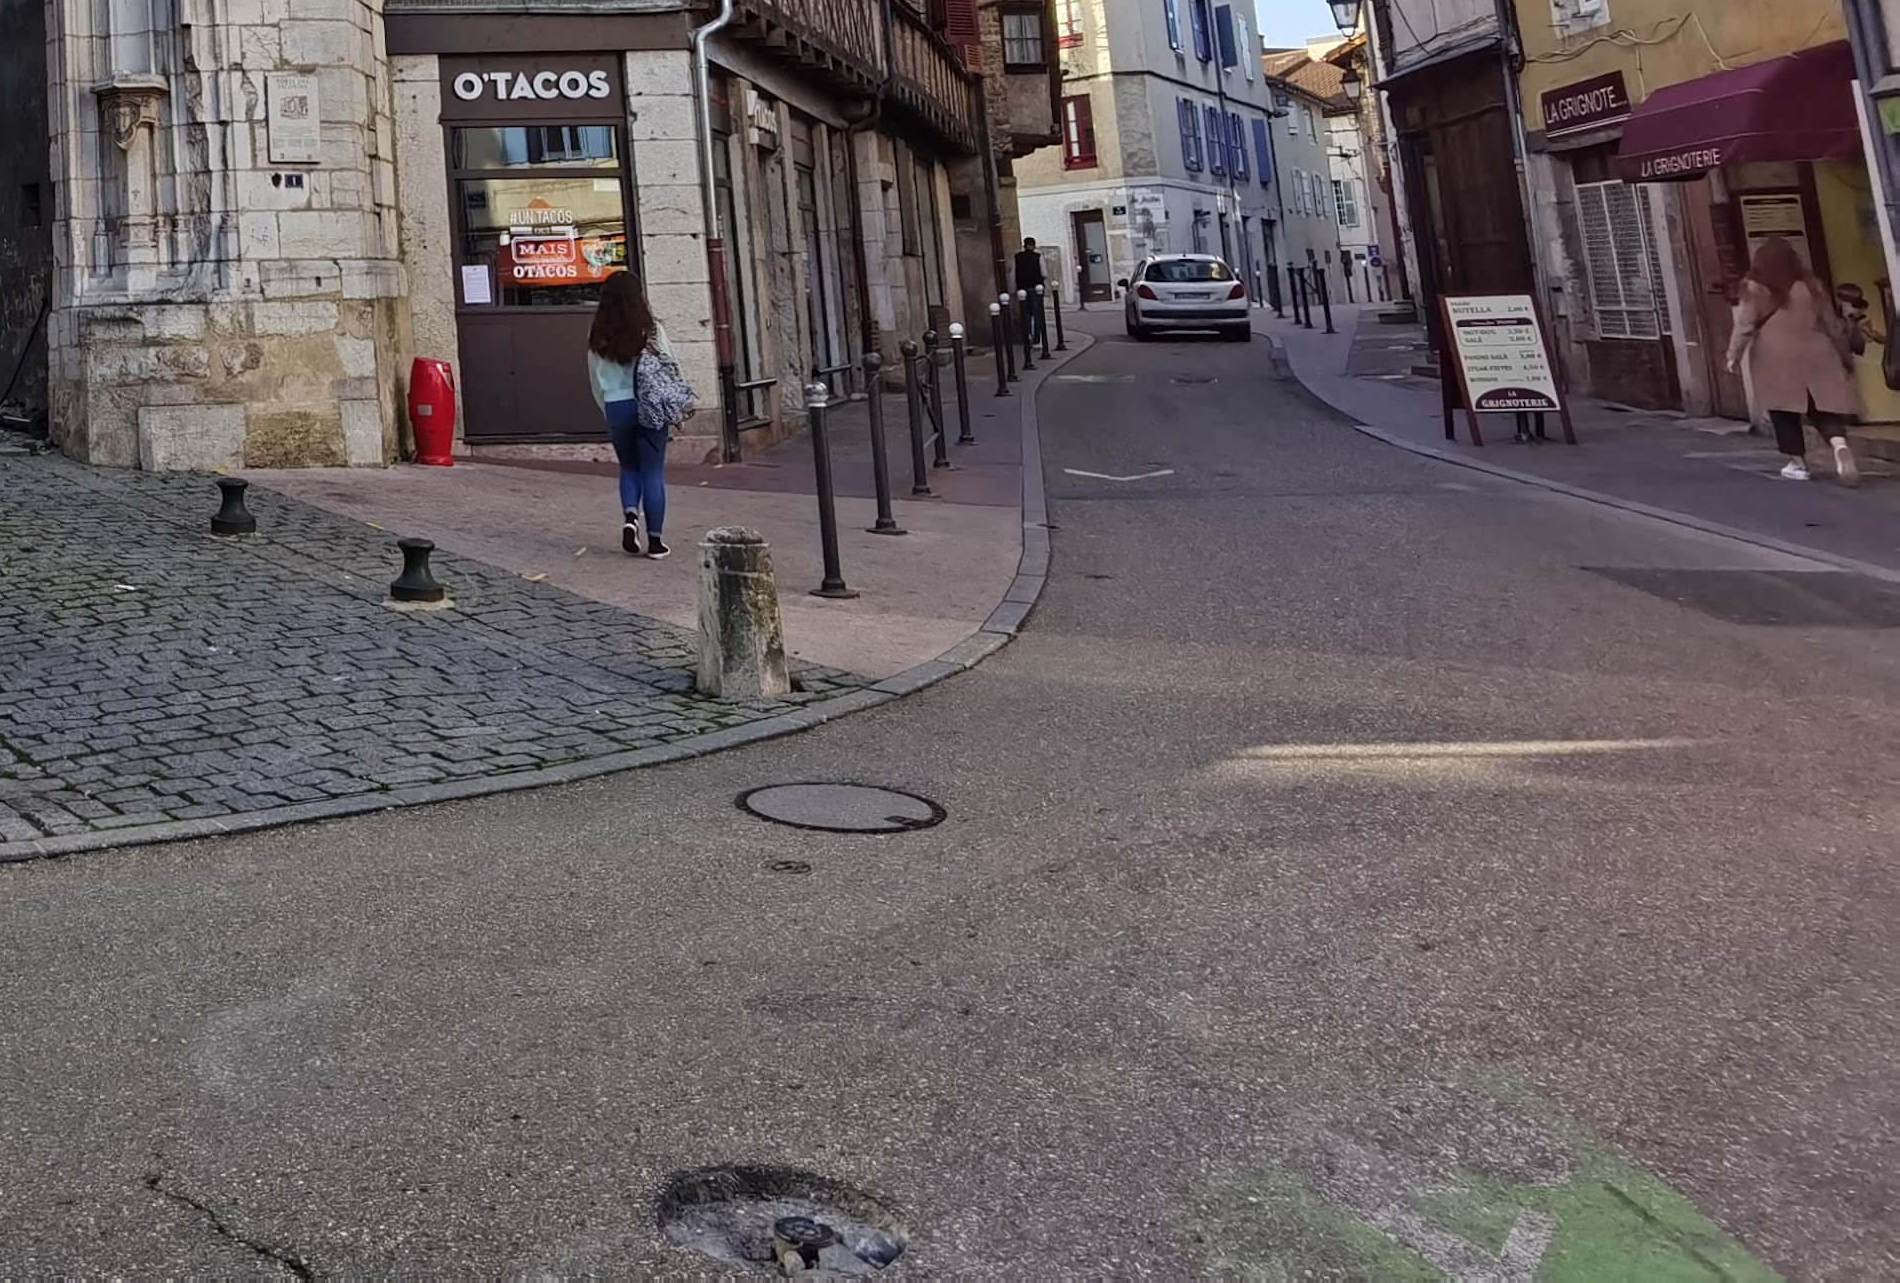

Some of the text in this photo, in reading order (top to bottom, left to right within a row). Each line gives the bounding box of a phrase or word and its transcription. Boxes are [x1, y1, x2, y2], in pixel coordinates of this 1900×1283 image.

[453, 70, 611, 100] O'TACOS
[1544, 104, 1560, 124] LA
[1641, 148, 1721, 178] LA GRIGNOTERIE
[538, 209, 573, 224] TACOS
[519, 243, 568, 255] MAIS
[1452, 306, 1492, 314] NUTELLA
[1481, 398, 1548, 408] GRIGNOTERIE
